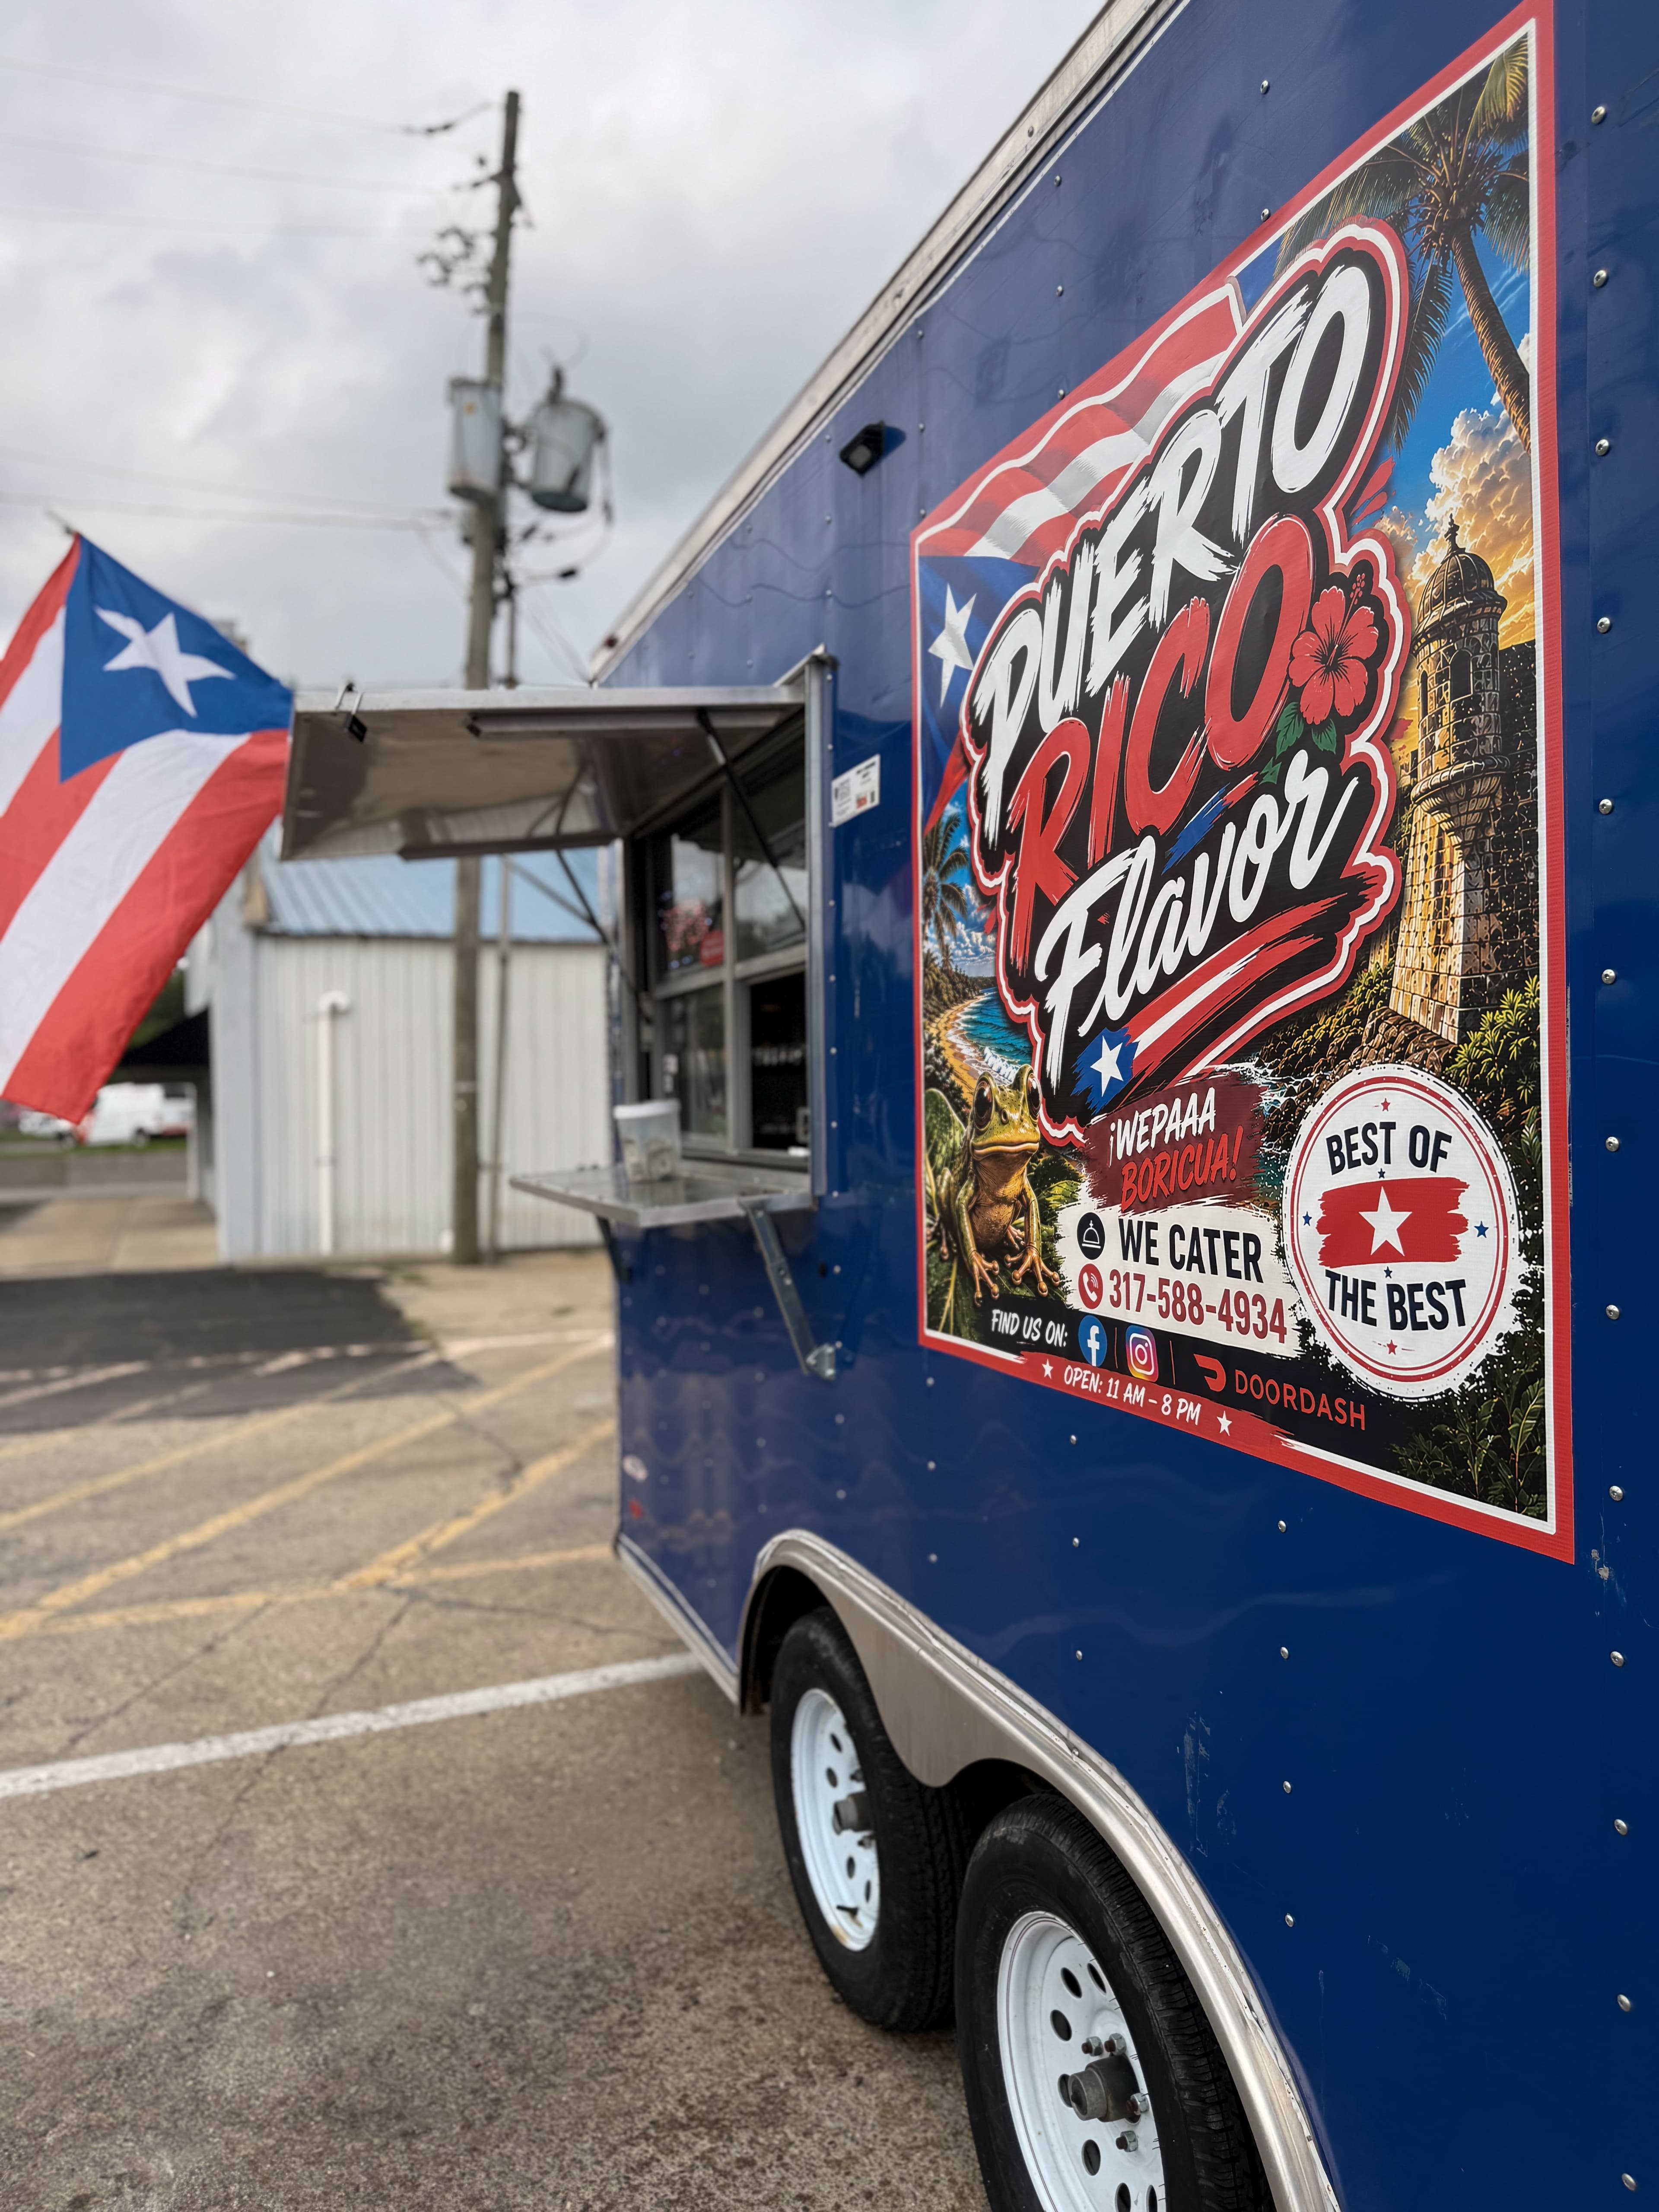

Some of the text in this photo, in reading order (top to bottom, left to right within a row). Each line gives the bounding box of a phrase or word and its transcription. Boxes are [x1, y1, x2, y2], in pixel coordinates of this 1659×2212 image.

[975, 265, 1370, 850] PUERTO
[1006, 515, 1313, 976] RICO
[1035, 749, 1359, 1096] Flavor
[1109, 1087, 1215, 1167] ¡WEPAAA
[1325, 1121, 1452, 1176] BEST OF
[1121, 1125, 1244, 1211] BORICUA!
[1118, 1218, 1264, 1283] WE CATER
[992, 1309, 1068, 1348] FIND US ON:
[1109, 1269, 1287, 1344] 317-588-4934
[1325, 1269, 1467, 1332] THE BEST
[1064, 1364, 1103, 1394] OPEN:
[1106, 1378, 1119, 1399] 11
[1123, 1383, 1144, 1408] AM
[1161, 1395, 1172, 1416] 8
[1177, 1398, 1201, 1426] PM
[1234, 1369, 1366, 1431] DOORDASH
